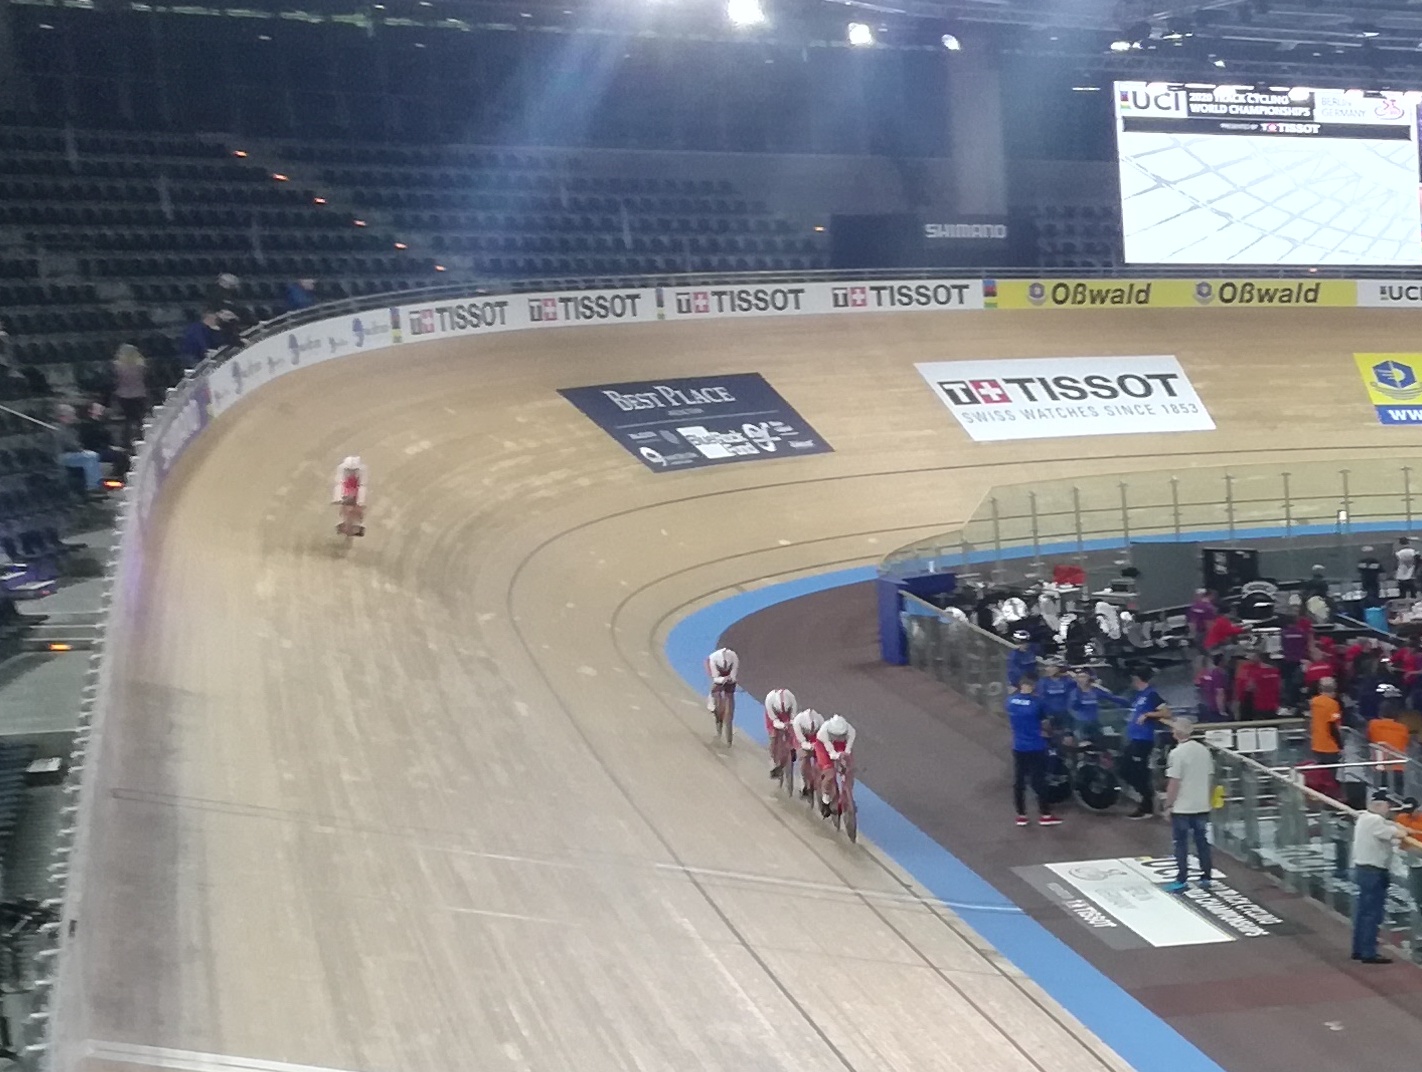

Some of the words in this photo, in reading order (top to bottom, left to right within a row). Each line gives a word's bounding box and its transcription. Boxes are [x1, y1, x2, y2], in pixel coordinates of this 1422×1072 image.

[1131, 90, 1181, 111] UCI
[1189, 104, 1227, 115] WORLD
[1229, 105, 1311, 117] CHAMPIONSHIPS
[925, 223, 1007, 240] SHIMANO
[711, 289, 805, 313] TISSOT
[870, 284, 969, 307] TISSOT
[1051, 282, 1151, 305] Oßwald
[1219, 282, 1320, 305] Oßwald
[435, 301, 509, 331] TISSOT
[563, 294, 641, 319] TISSOT
[604, 390, 667, 411] BEST
[654, 385, 737, 407] PLACE
[1003, 373, 1179, 403] TISSOT
[961, 408, 1017, 425] SWISS
[1022, 406, 1100, 423] WATCHES
[1103, 404, 1157, 418] SINCE
[1160, 402, 1200, 416] 1853
